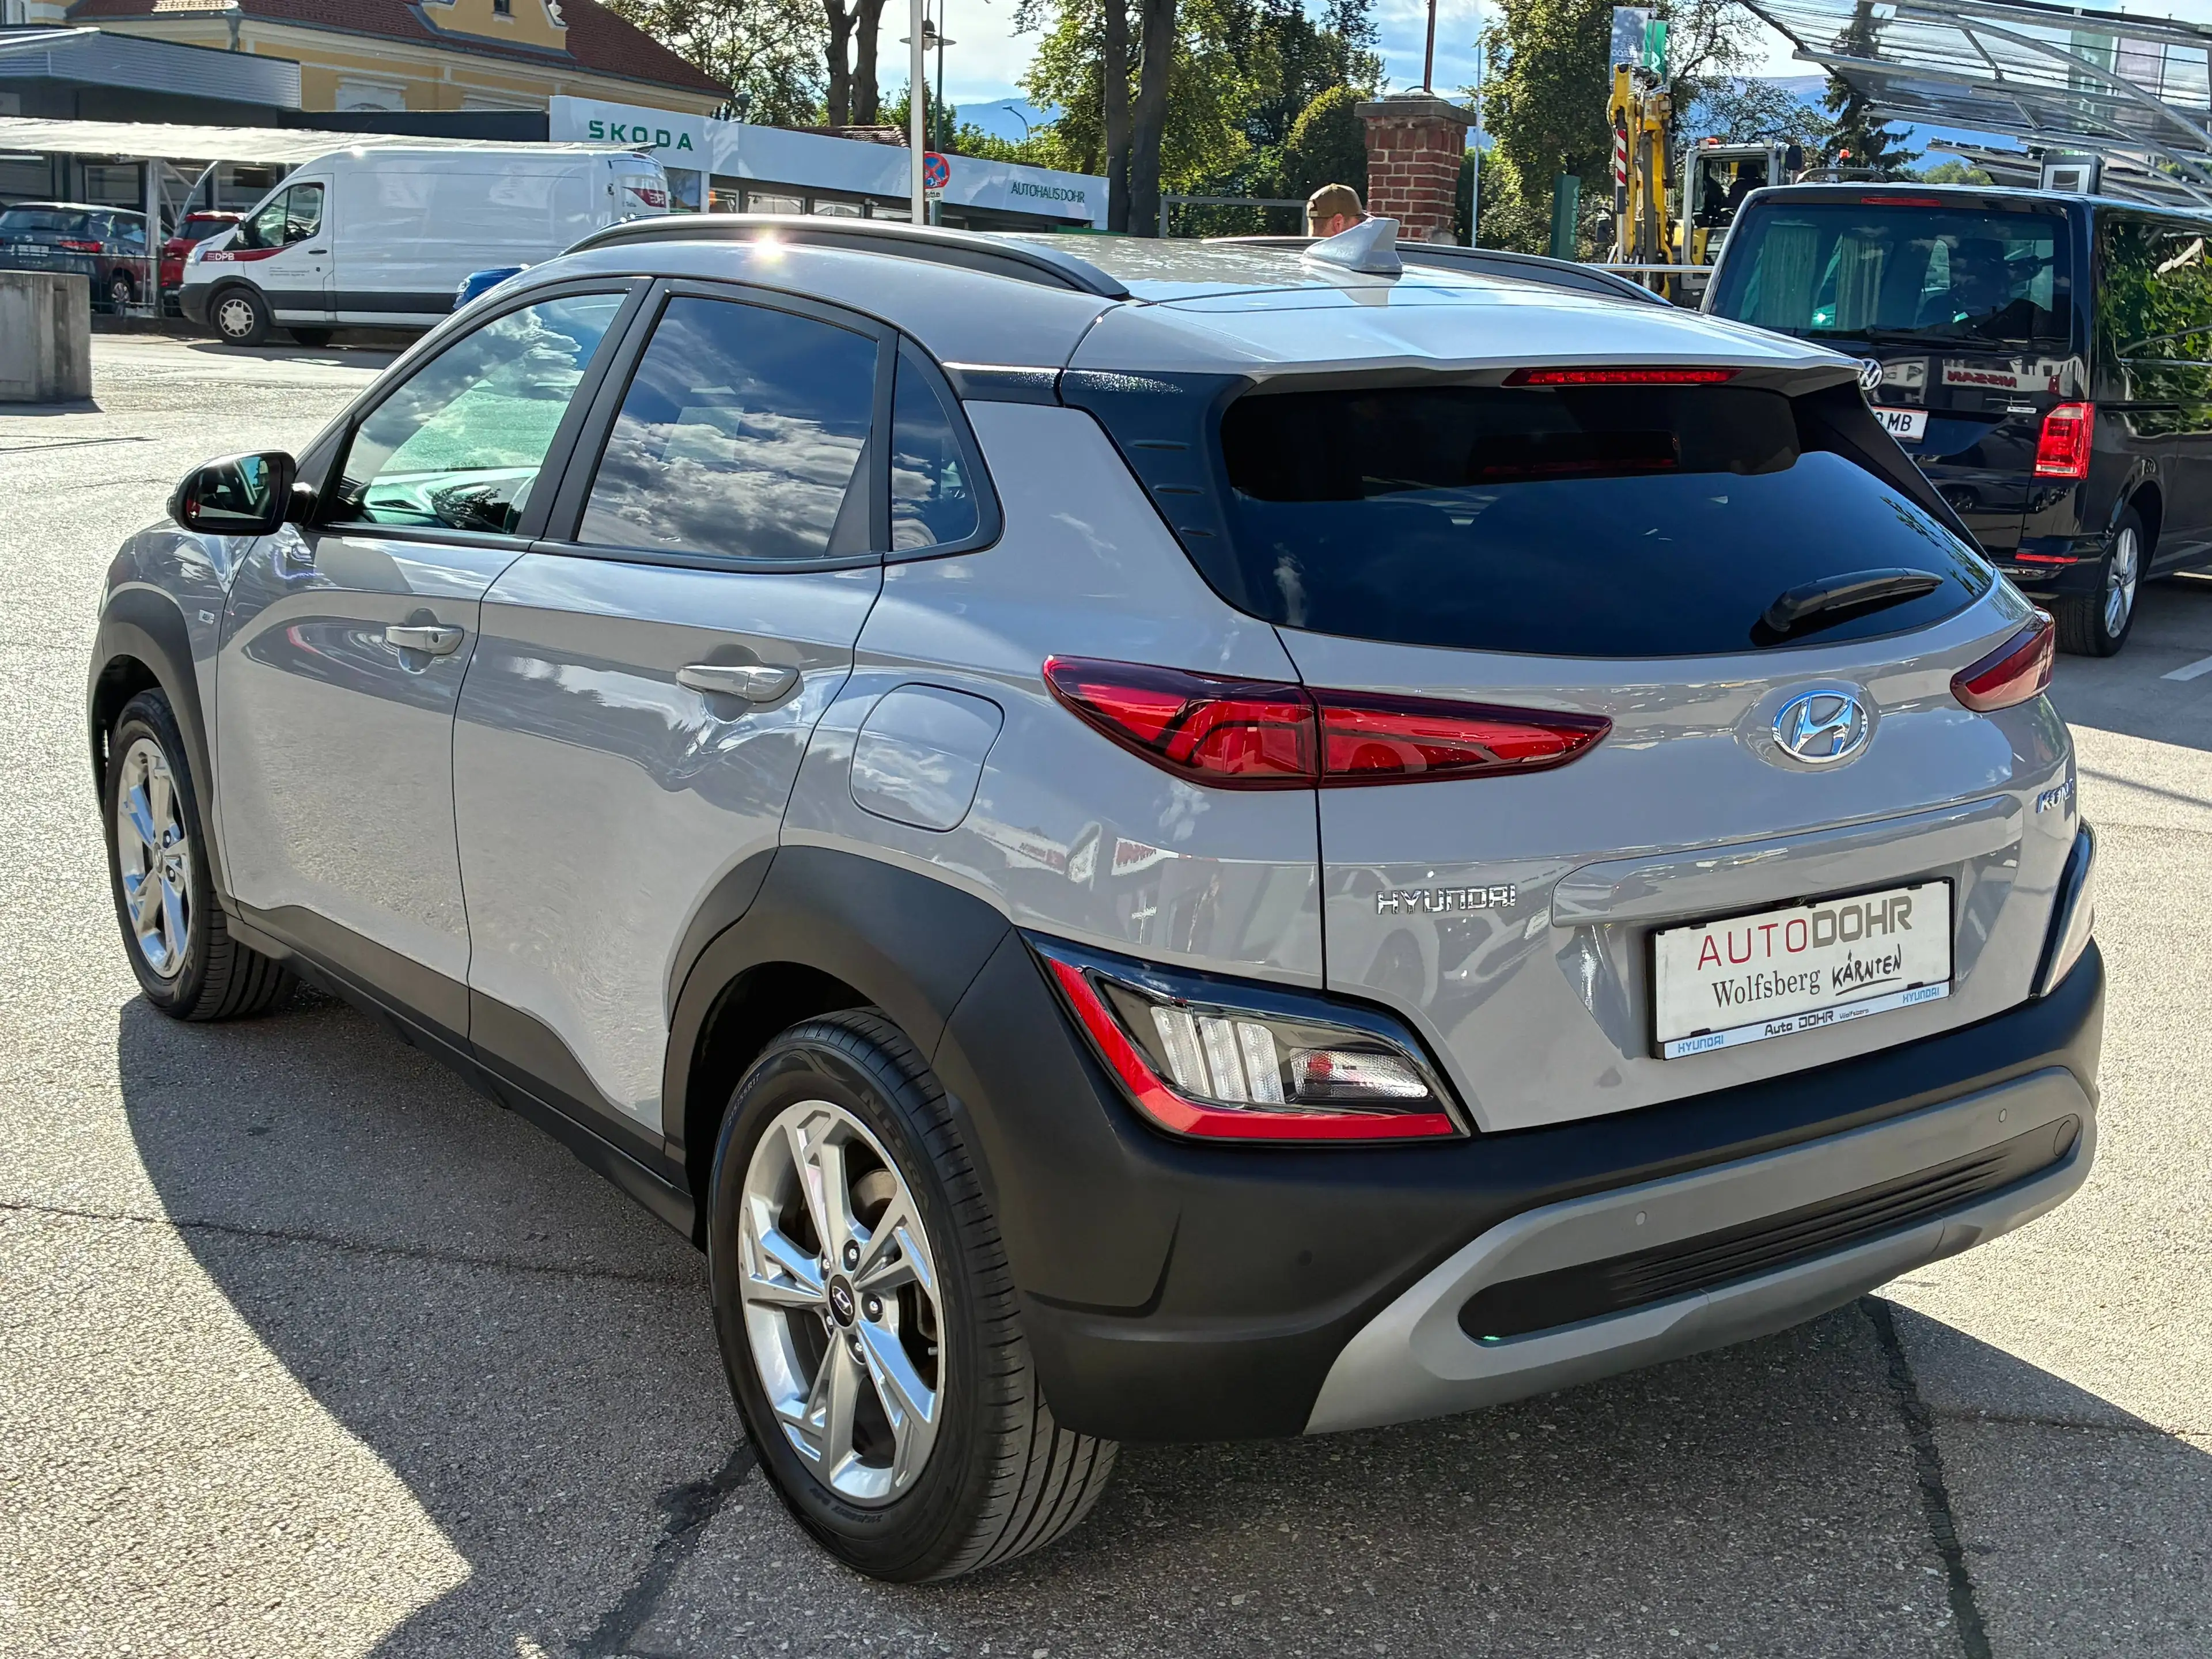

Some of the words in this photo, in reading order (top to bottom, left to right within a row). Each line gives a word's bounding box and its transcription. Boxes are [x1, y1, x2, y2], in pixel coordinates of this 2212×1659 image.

[1377, 883, 1518, 915] HYUNDAI
[1712, 969, 1821, 1008] Wolfsberg
[1903, 987, 1940, 1004] HYUNDAI
[1764, 1022, 1793, 1036] Auto
[1798, 1010, 1834, 1029] DOHR
[1677, 1035, 1724, 1054] HYUNDAI
